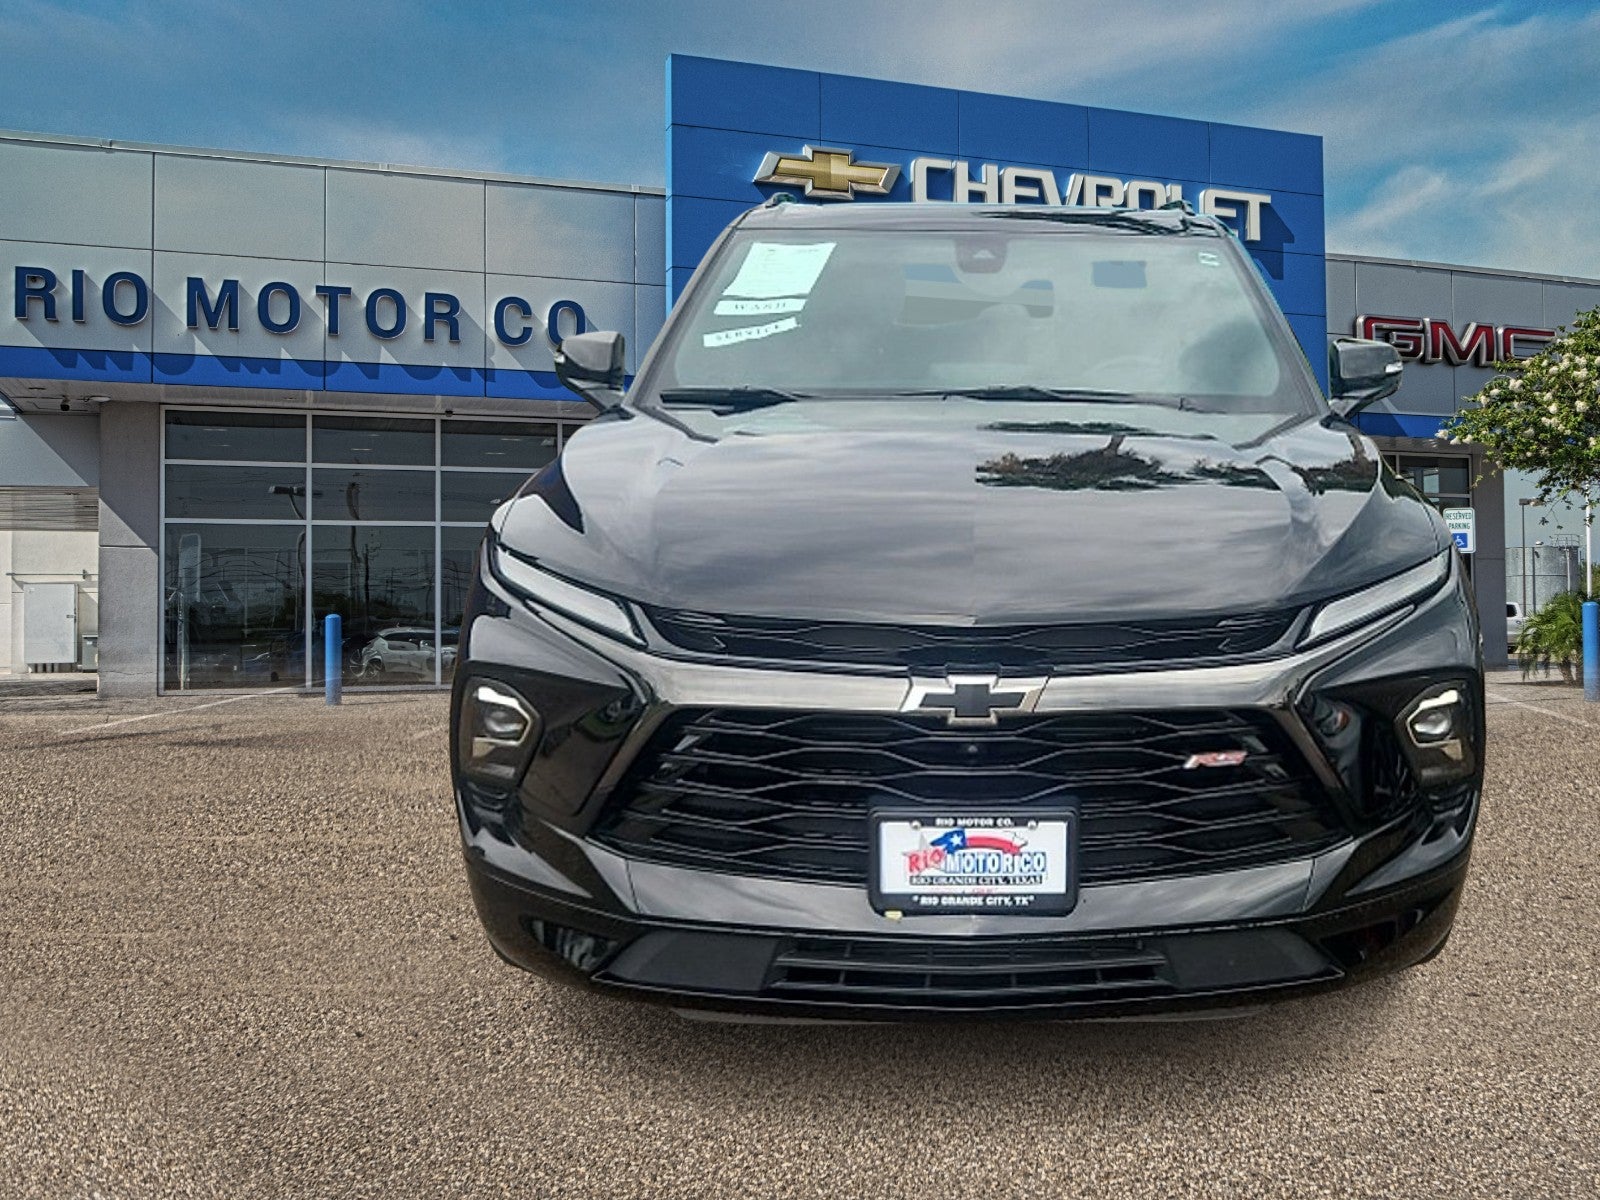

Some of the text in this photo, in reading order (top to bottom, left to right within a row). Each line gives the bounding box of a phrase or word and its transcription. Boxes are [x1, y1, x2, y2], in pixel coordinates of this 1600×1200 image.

[14, 266, 586, 346] RIO MOTOR CO
[1356, 314, 1556, 367] GMC
[1446, 512, 1472, 520] RESERVED
[935, 817, 1015, 827] RIO MOTOR CO.
[909, 848, 945, 873] RIO
[945, 852, 1046, 873] MOTOR CO
[941, 894, 983, 906] GRANDE
[986, 894, 1013, 907] CITY,
